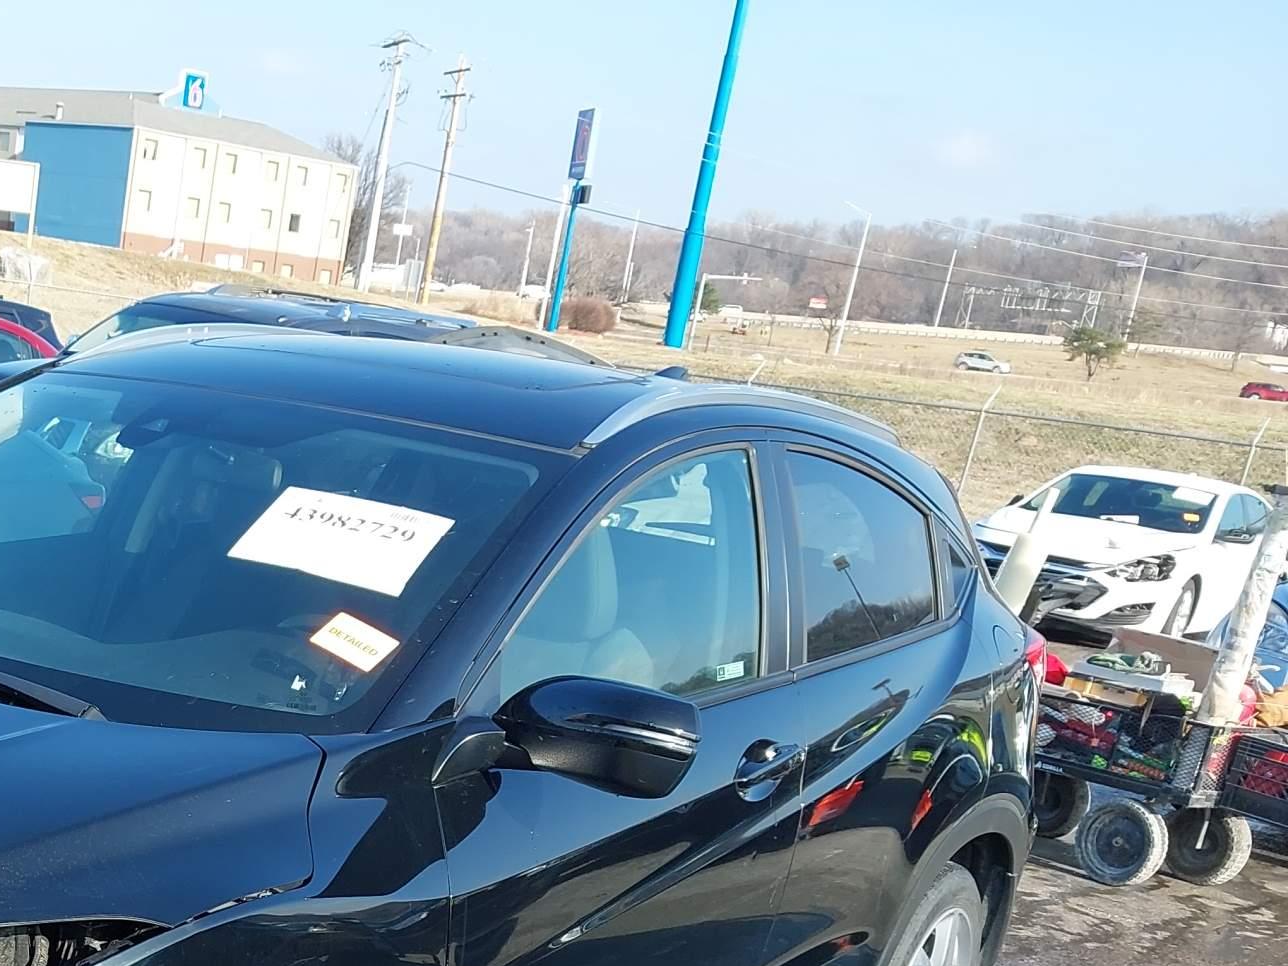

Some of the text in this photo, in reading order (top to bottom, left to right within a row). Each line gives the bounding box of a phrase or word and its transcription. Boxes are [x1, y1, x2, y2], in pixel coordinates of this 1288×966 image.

[189, 77, 203, 107] 6
[284, 506, 416, 543] 43982729
[328, 626, 379, 657] DETAILED
